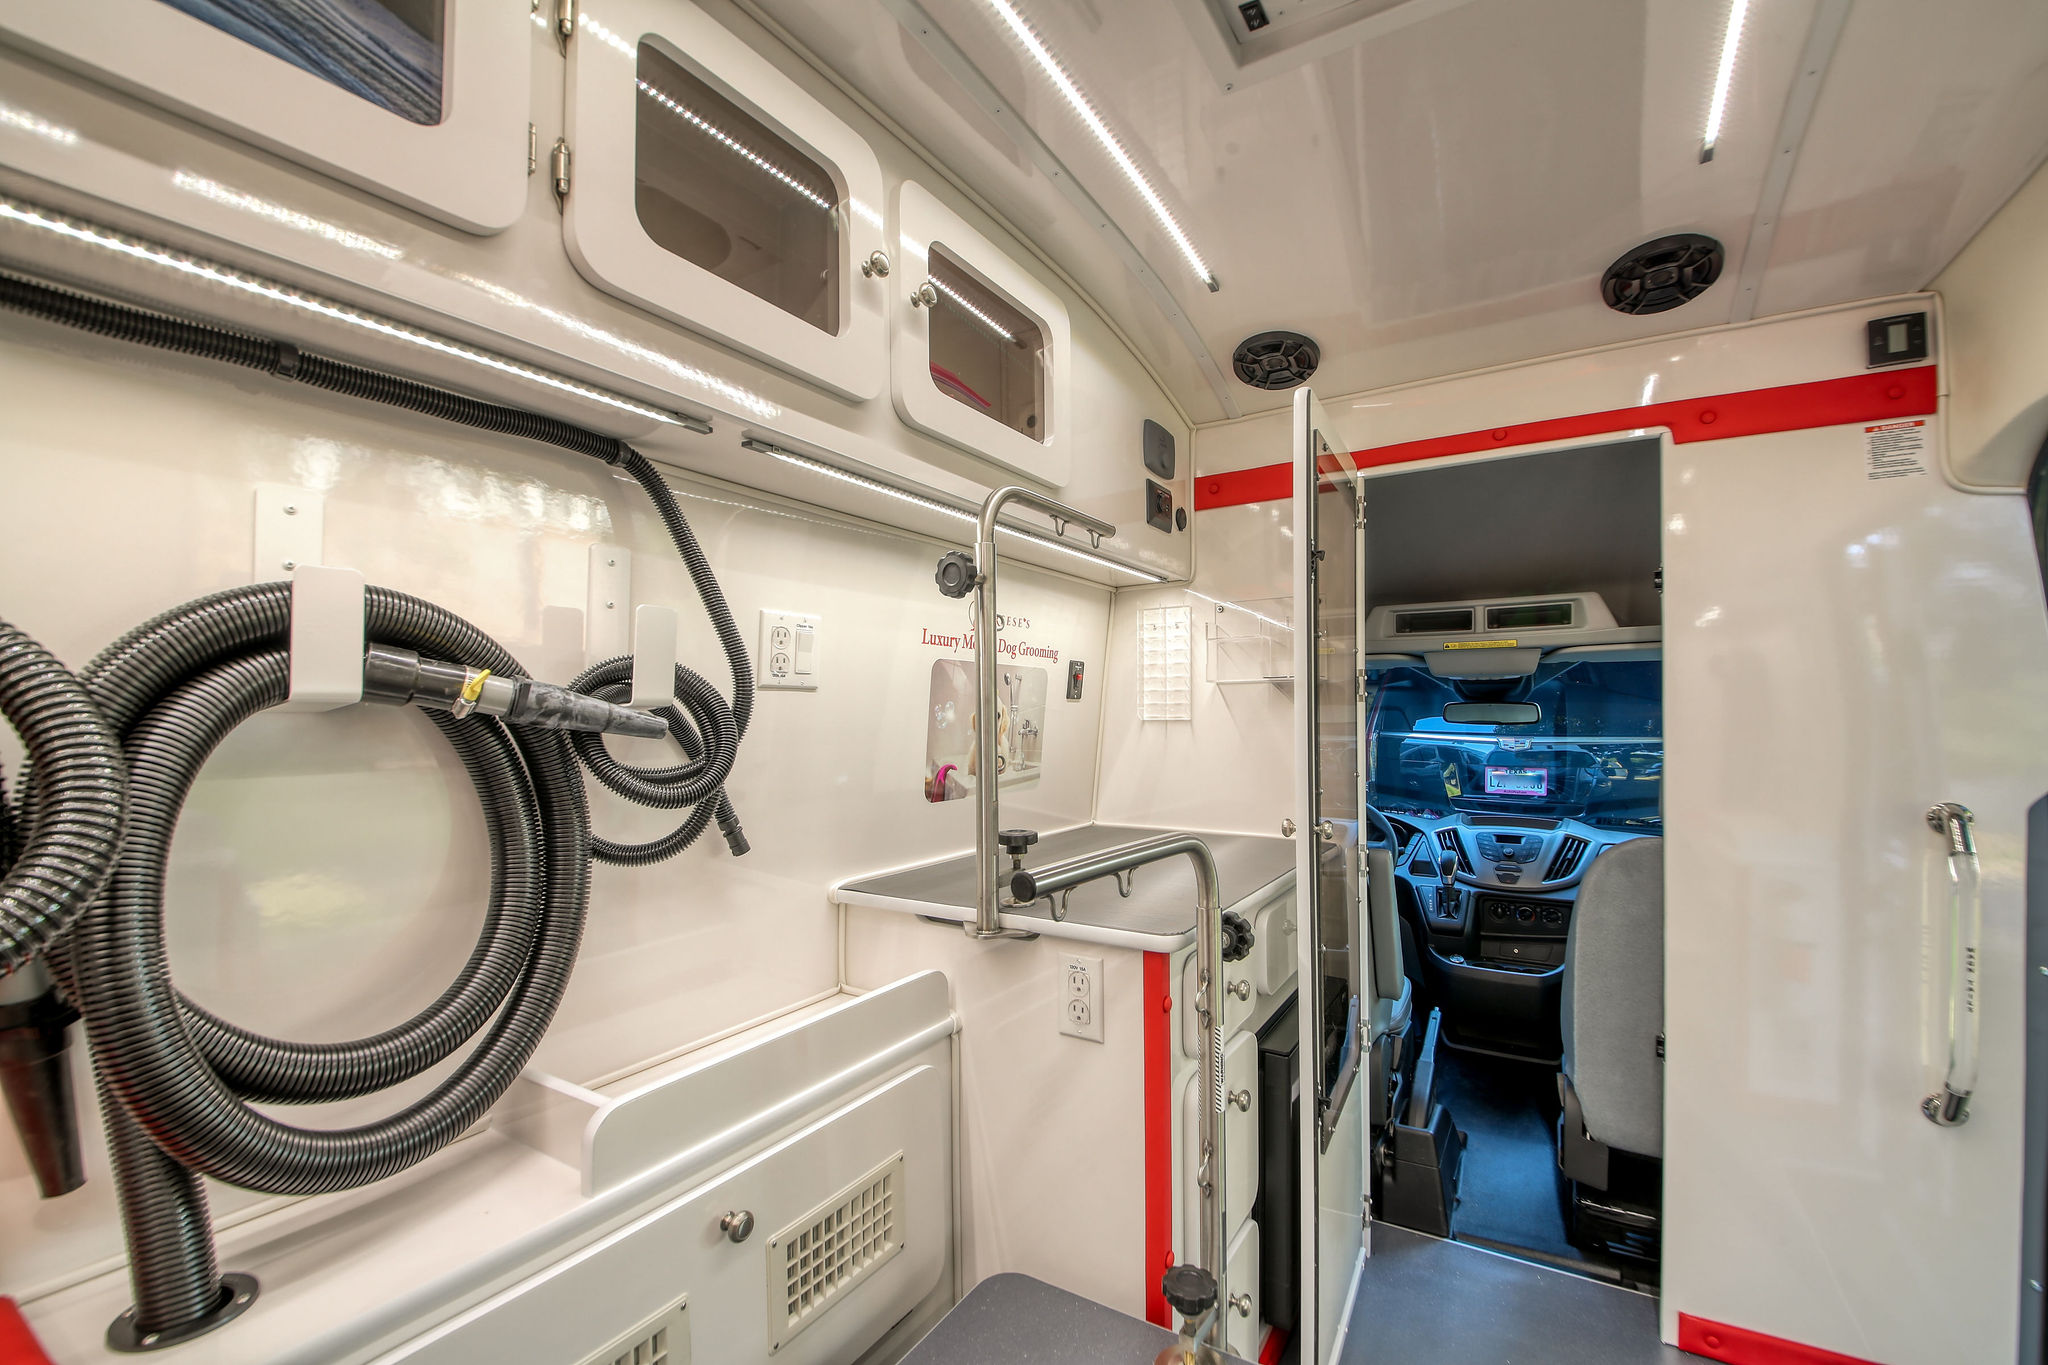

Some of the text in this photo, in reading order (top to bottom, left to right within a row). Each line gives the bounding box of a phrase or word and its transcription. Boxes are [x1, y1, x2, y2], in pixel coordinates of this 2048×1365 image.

[921, 627, 961, 653] Luxury
[997, 638, 1018, 660] Dog
[1018, 641, 1059, 664] Grooming
